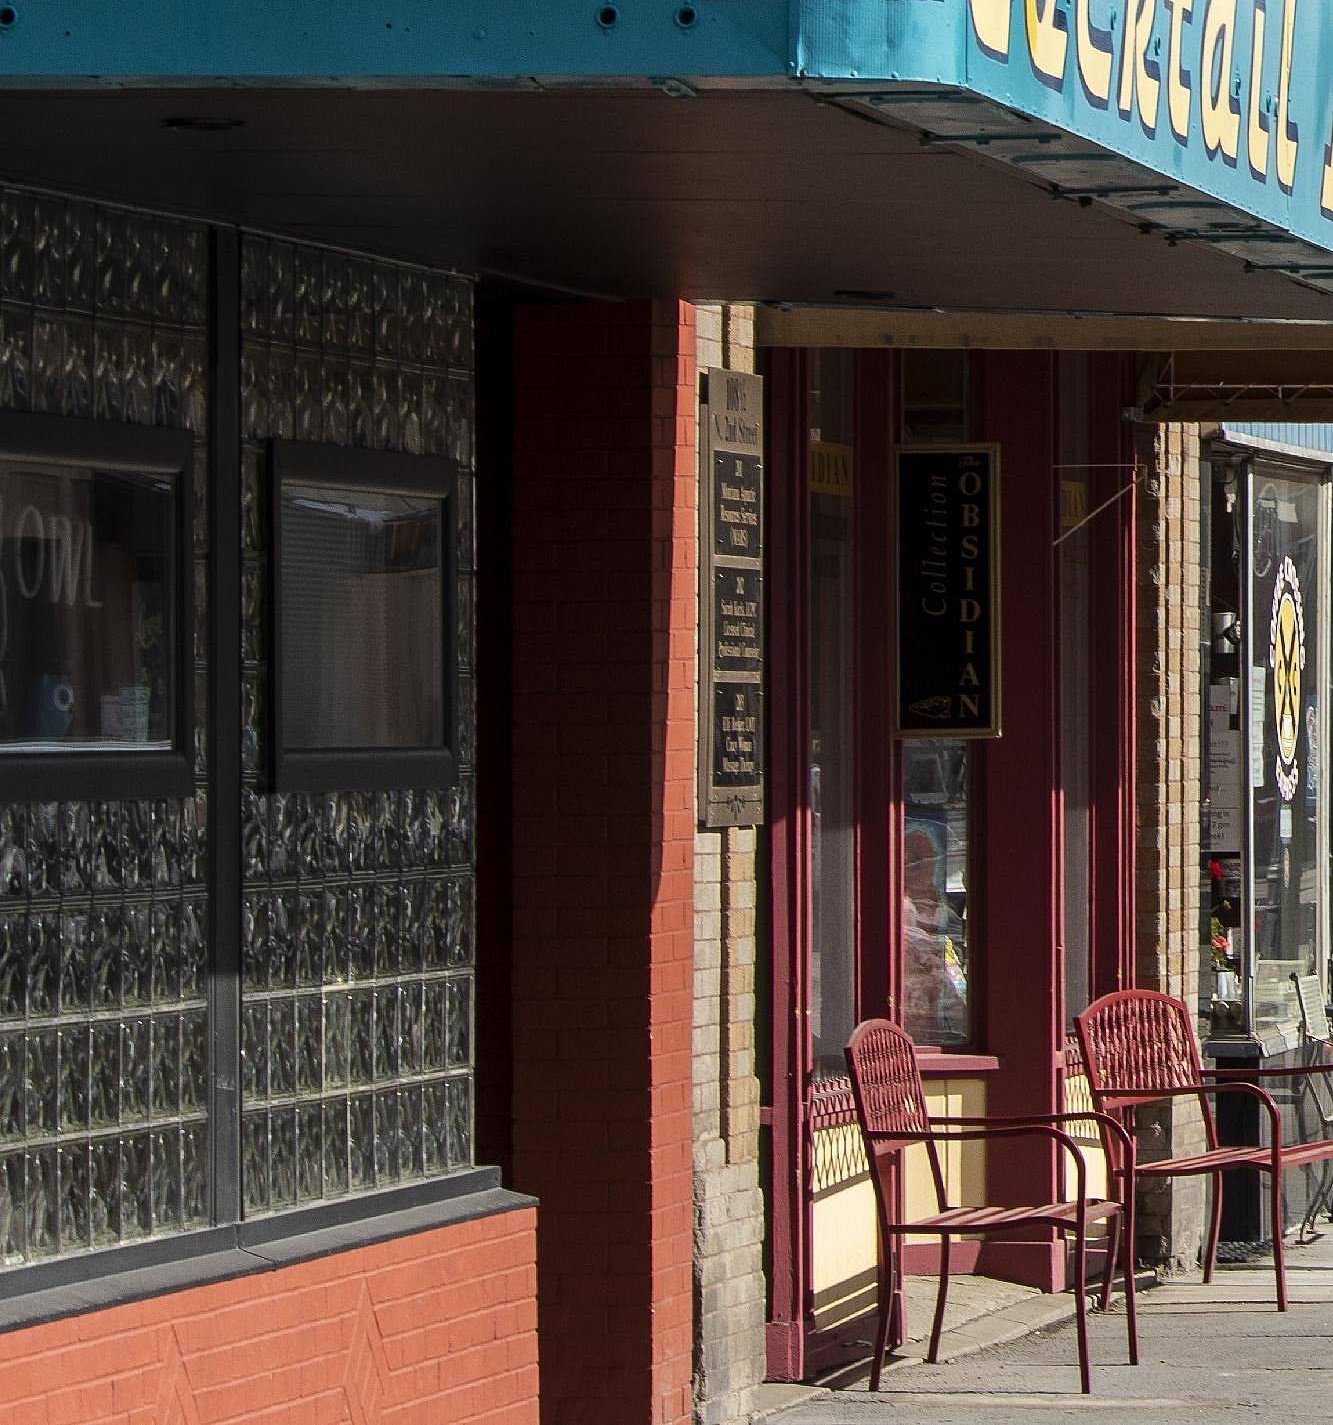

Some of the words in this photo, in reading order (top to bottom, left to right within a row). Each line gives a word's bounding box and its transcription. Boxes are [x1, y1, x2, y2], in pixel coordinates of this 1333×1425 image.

[15, 504, 104, 608] OWL
[920, 473, 949, 617] Collection
[957, 471, 983, 719] OBSIDIAN
